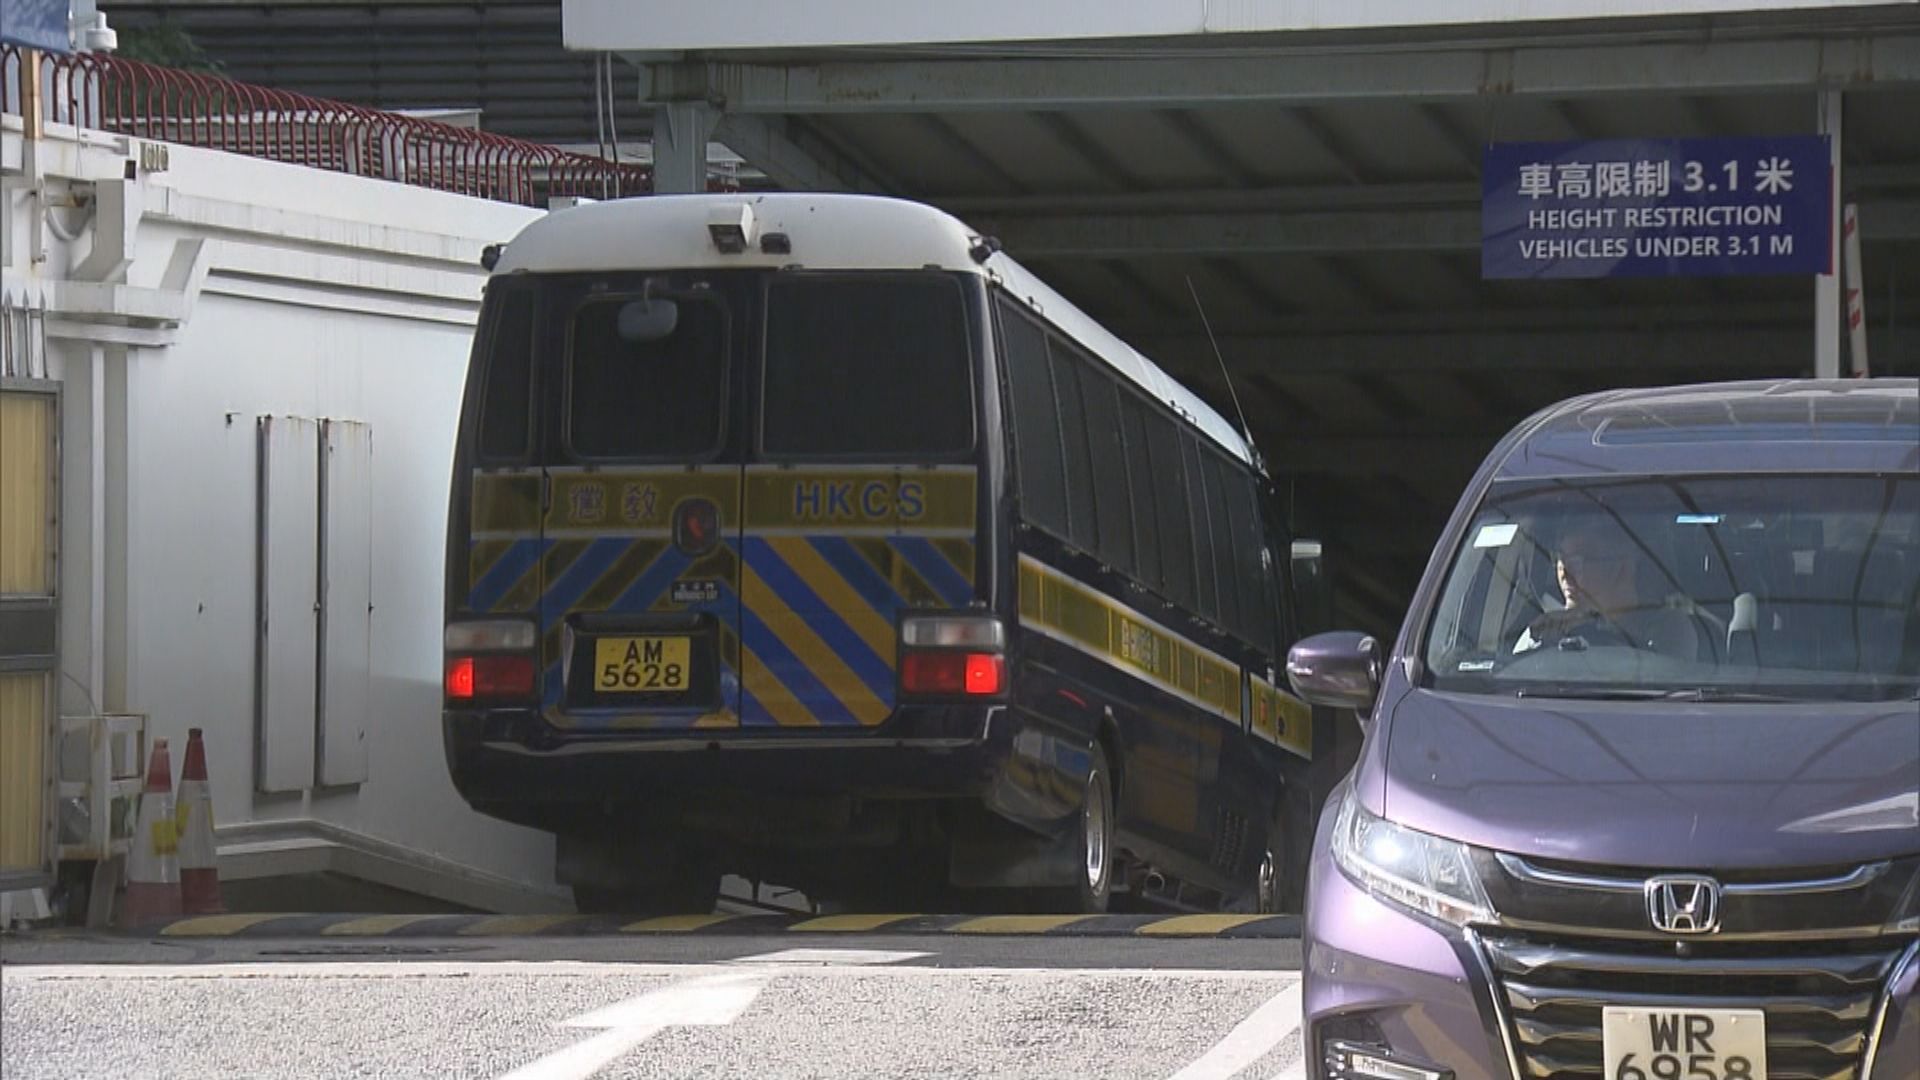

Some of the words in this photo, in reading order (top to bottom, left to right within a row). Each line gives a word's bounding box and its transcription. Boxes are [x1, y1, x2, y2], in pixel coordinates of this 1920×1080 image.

[1518, 160, 1670, 199] 車高限制
[1684, 160, 1739, 193] 3.1
[1754, 157, 1794, 195] 米
[1528, 208, 1617, 229] HEIGHT
[1624, 206, 1782, 227] RESTRICTION
[1519, 239, 1628, 260] VEHICLES
[1635, 236, 1720, 257] UNDER
[1728, 236, 1760, 255] 3.1
[1769, 235, 1793, 255] M
[794, 483, 924, 517] HKCS
[623, 640, 662, 663] AM
[602, 664, 682, 687] 5628
[1649, 1013, 1715, 1053] WR
